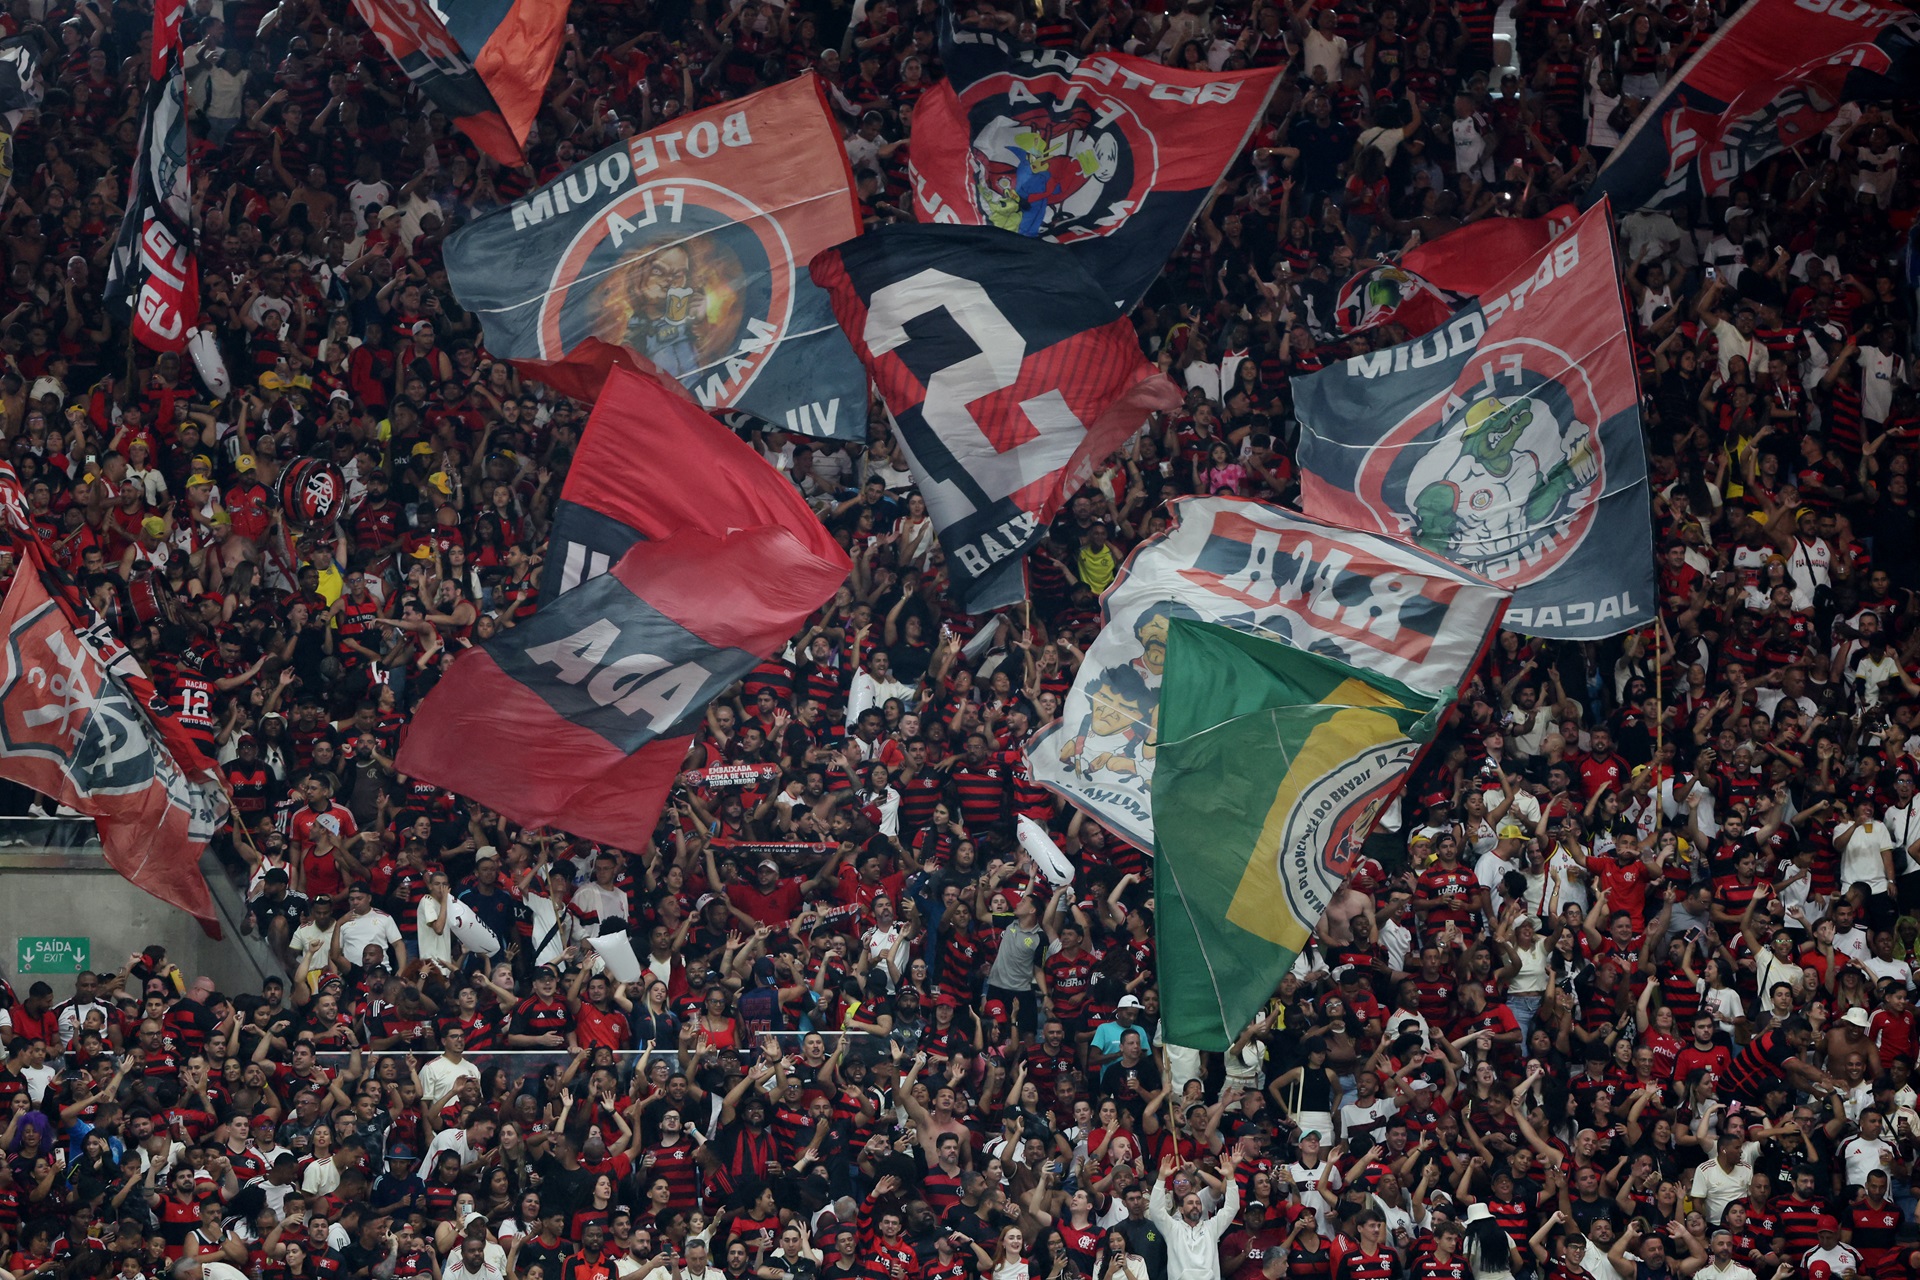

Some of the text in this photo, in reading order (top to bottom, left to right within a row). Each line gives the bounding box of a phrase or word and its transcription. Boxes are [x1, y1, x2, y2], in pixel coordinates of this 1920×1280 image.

[185, 680, 207, 690] NAÇÃO
[181, 689, 209, 718] 12
[708, 765, 752, 775] EMBAIXADA
[705, 773, 728, 781] ACIMA
[740, 771, 759, 779] TUDO
[709, 778, 756, 787] RUBRO NEGRO
[35, 938, 72, 952] SAÍDA
[43, 953, 64, 963] EXIT
